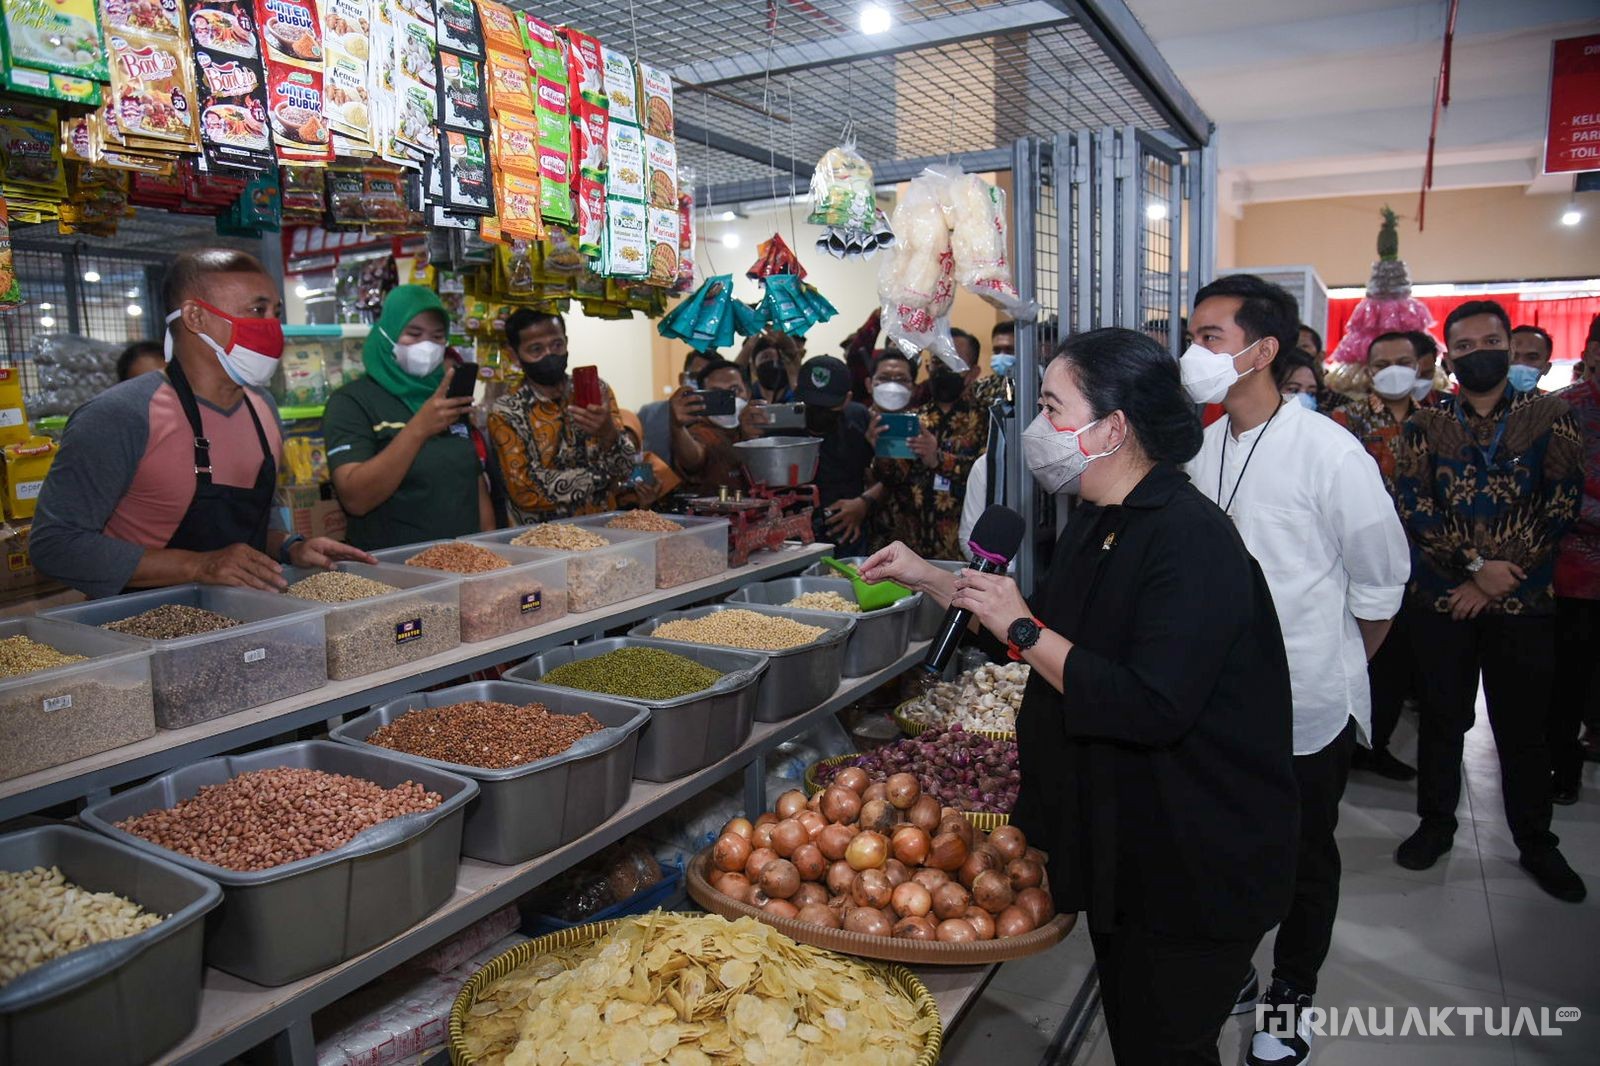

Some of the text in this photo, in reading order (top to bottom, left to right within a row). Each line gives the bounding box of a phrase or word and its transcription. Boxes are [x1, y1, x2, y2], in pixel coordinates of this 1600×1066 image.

[278, 12, 314, 31] BUBUK
[333, 66, 361, 85] Kencur
[173, 99, 186, 110] 30
[288, 96, 321, 113] BUBUK
